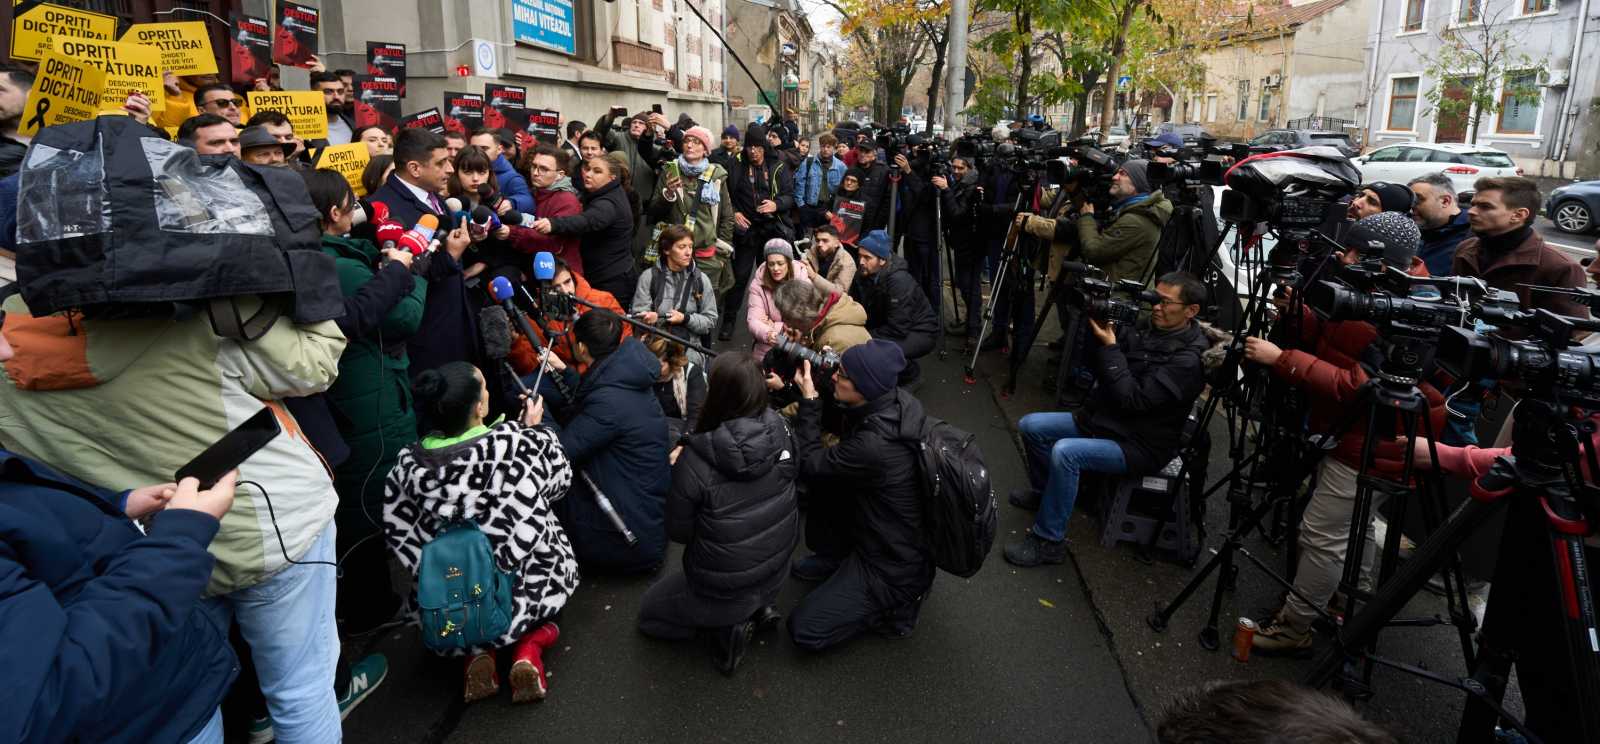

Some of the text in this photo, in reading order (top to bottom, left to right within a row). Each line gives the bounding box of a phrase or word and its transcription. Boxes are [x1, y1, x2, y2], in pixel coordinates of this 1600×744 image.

[513, 3, 538, 27] MIHAI
[540, 260, 553, 270] tve
[353, 672, 368, 694] N
